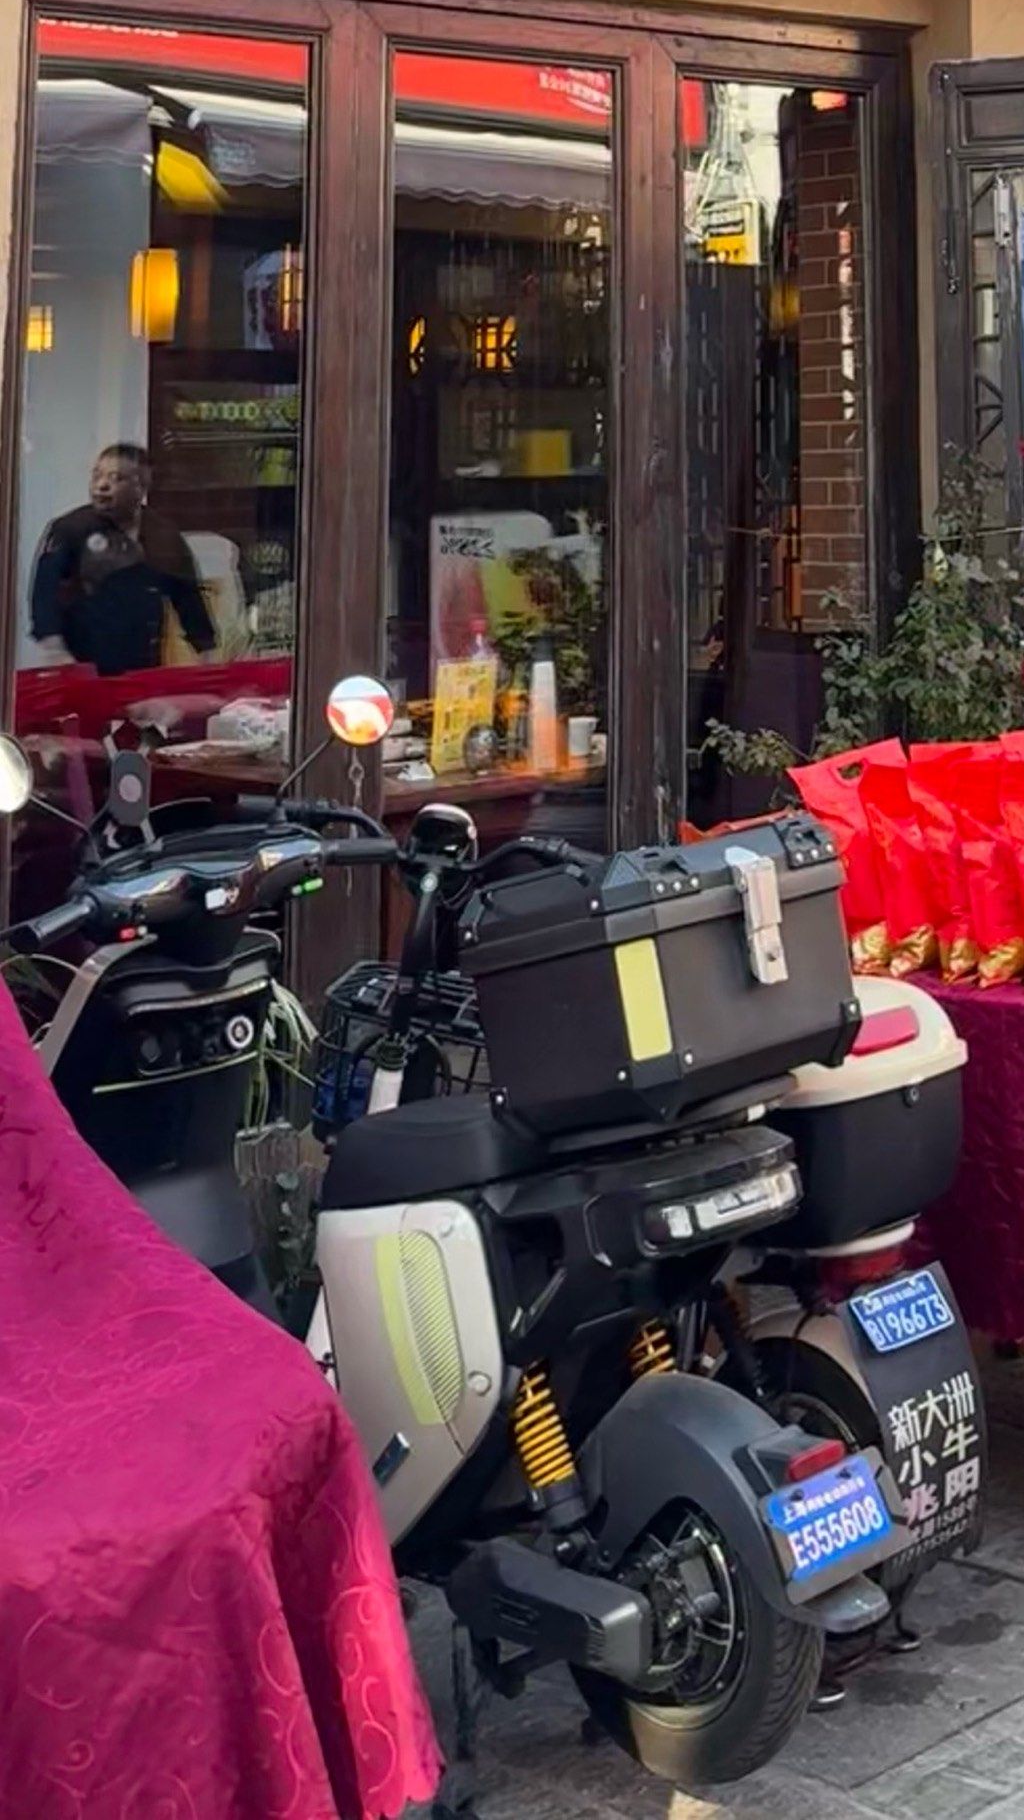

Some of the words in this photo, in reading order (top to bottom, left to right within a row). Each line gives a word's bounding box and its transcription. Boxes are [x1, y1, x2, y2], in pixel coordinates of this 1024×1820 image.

[865, 1293, 949, 1346] B196673
[888, 1371, 975, 1452] 新大洲
[899, 1422, 979, 1486] 小牛
[788, 1496, 883, 1569] E555608
